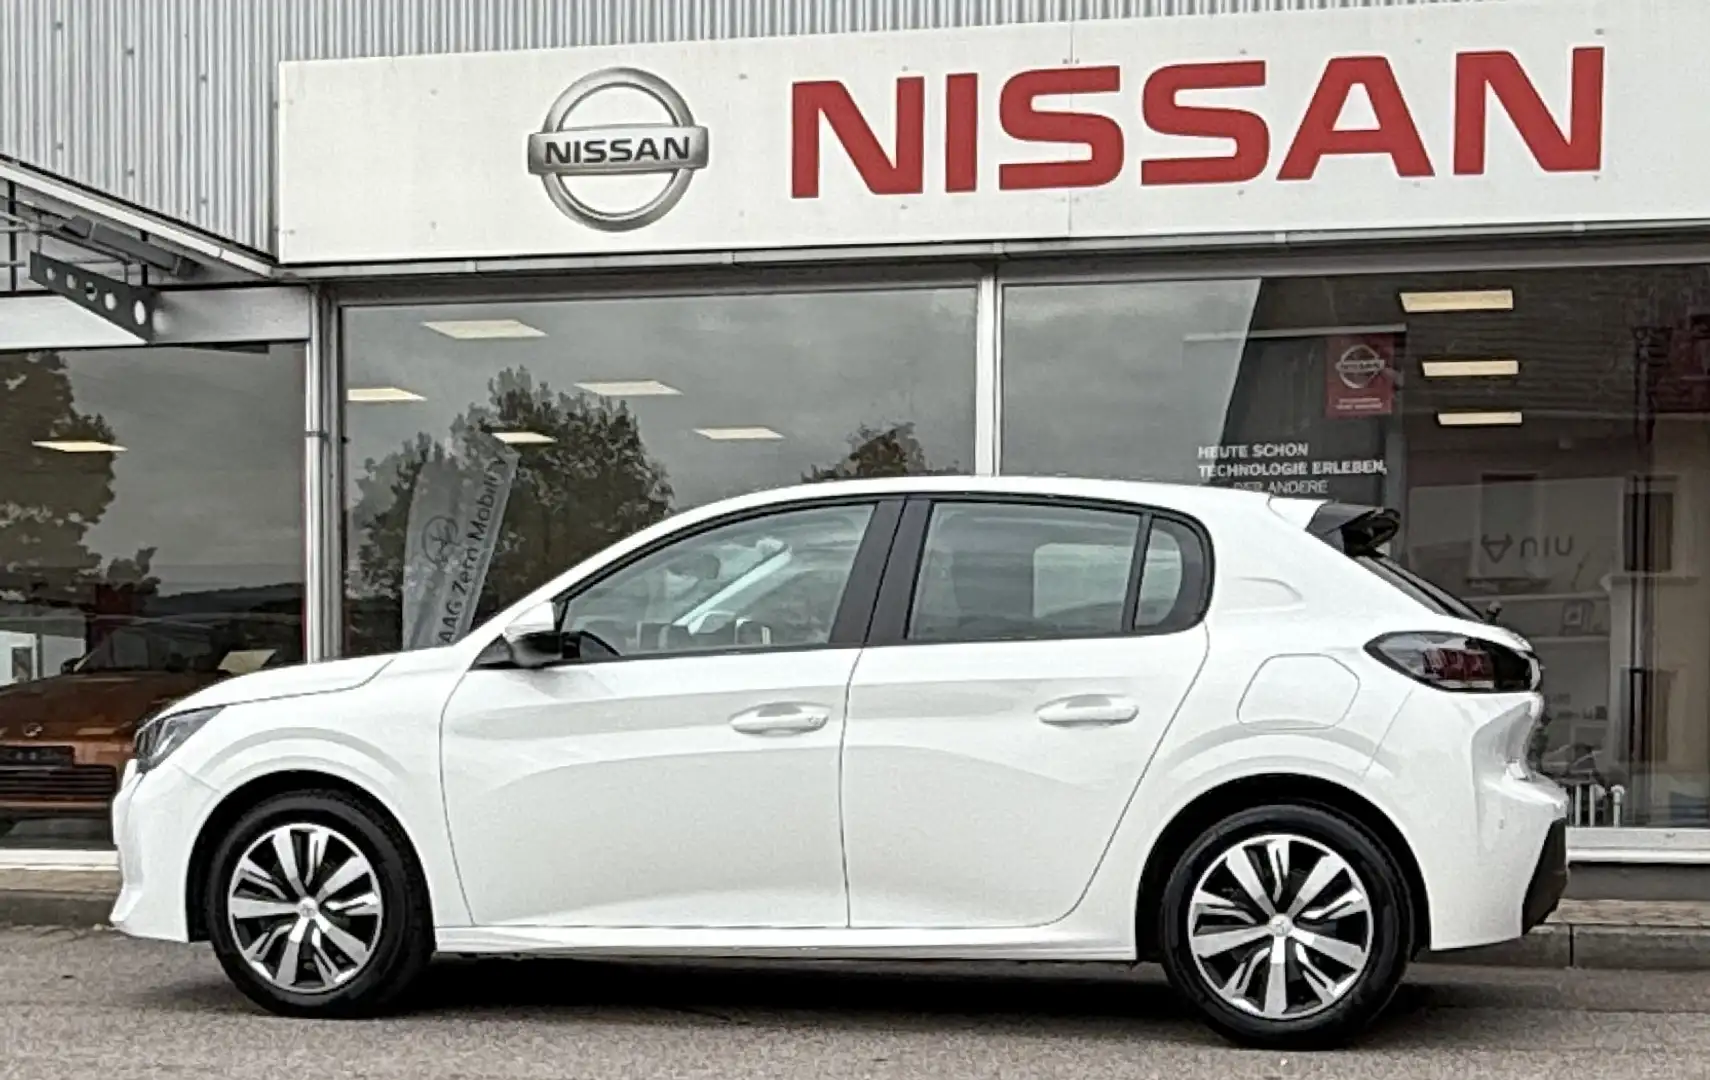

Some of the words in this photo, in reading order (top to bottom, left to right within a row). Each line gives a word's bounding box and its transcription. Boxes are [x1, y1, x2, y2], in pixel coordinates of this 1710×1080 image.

[791, 46, 1605, 199] NISSAN
[545, 136, 690, 165] NISSAN
[1198, 445, 1248, 459] HEUTE
[1252, 442, 1309, 458] SCHON
[1198, 461, 1308, 478] TECHNOLOGIE
[1267, 479, 1328, 494] ANDERE
